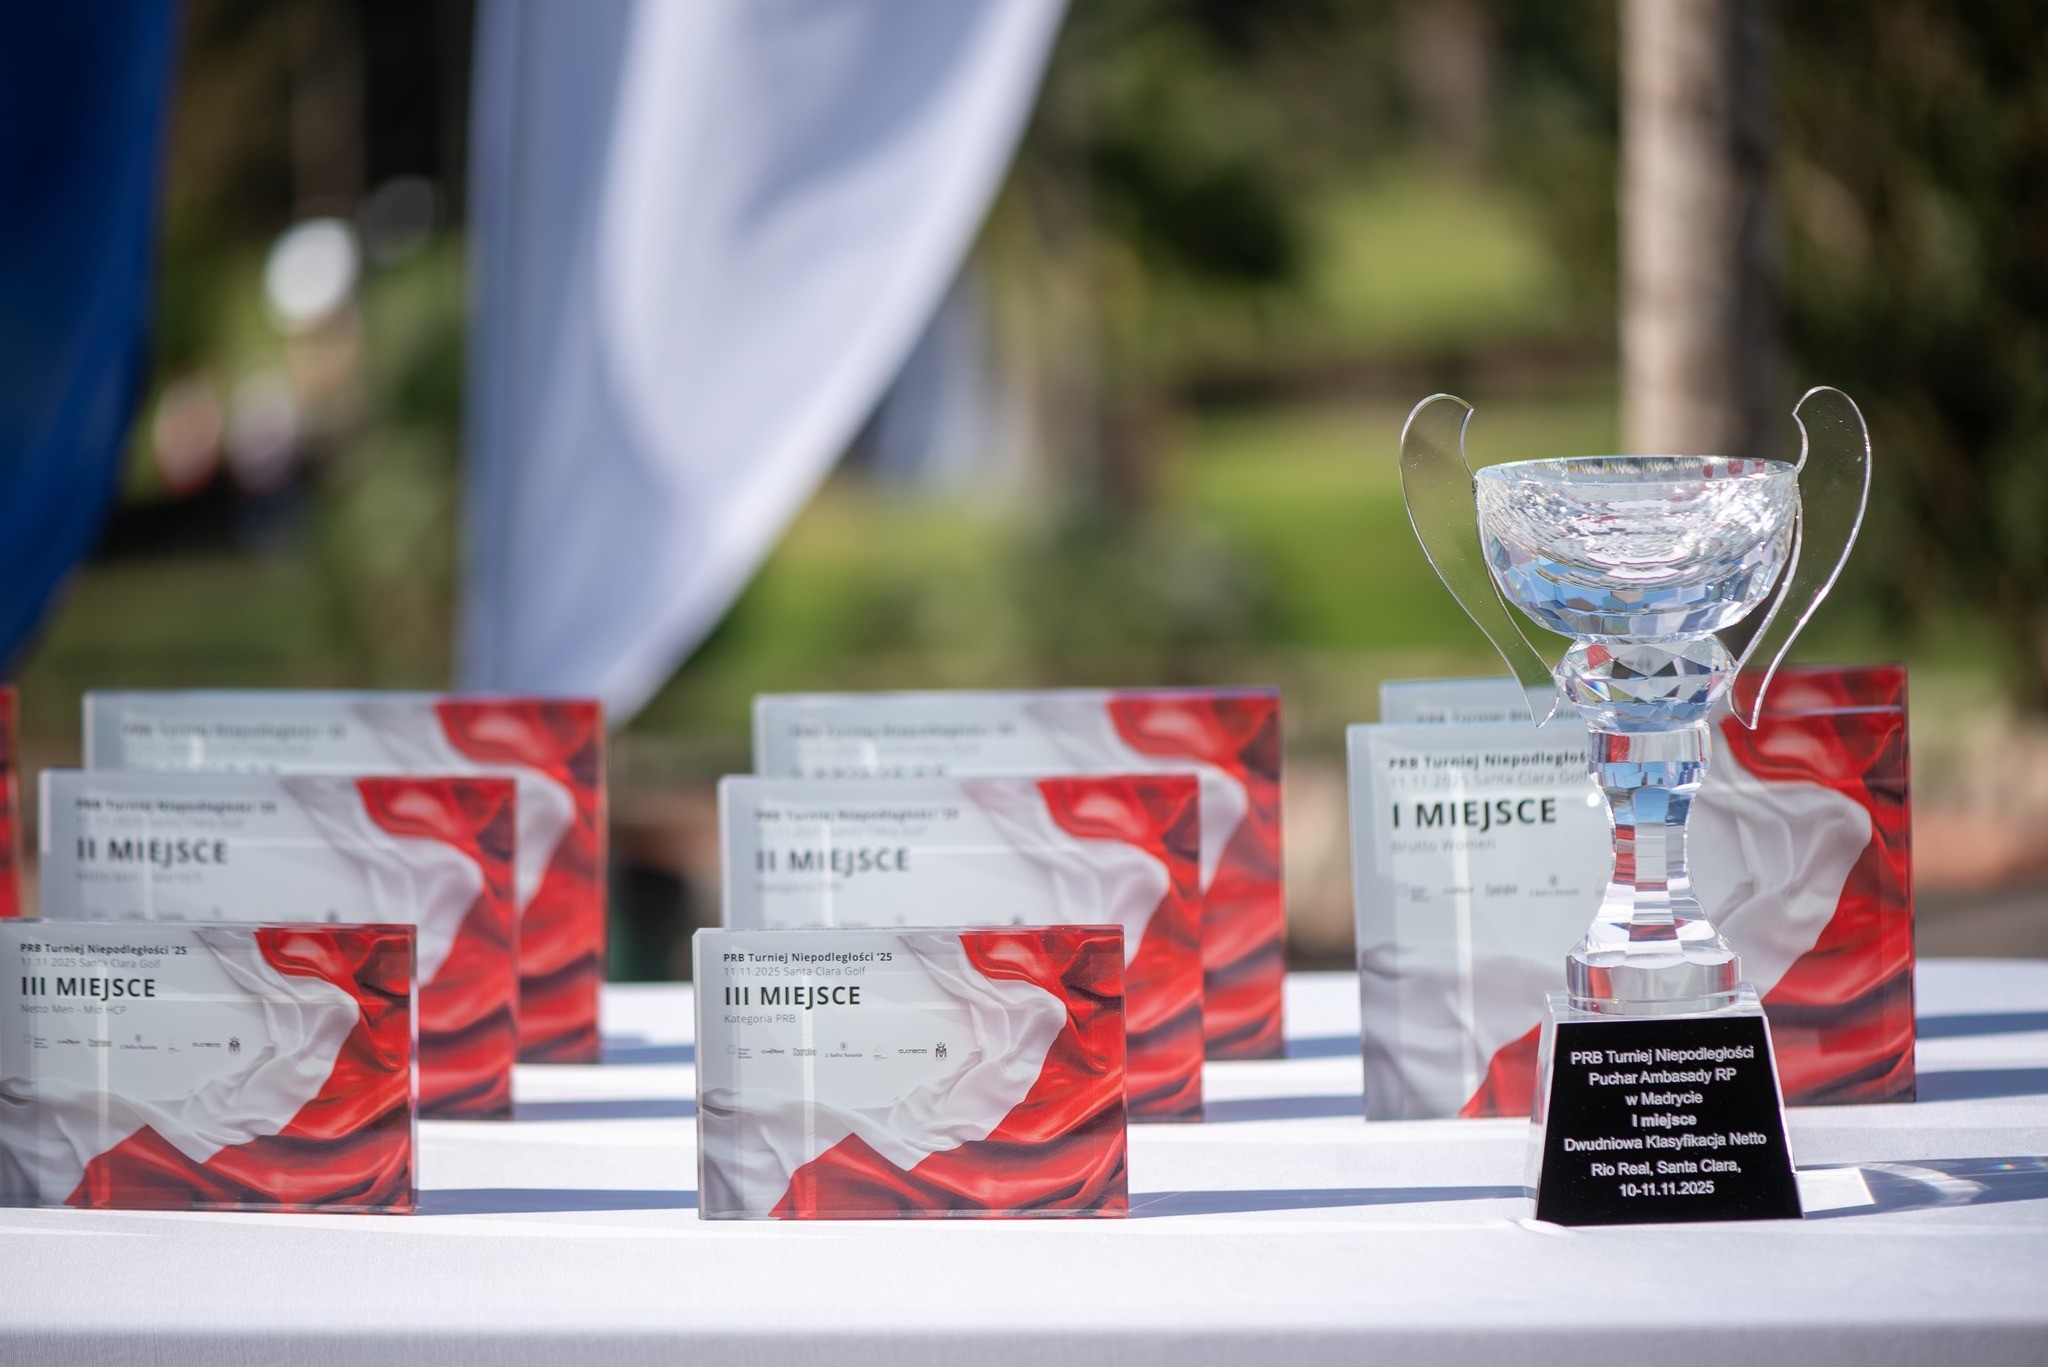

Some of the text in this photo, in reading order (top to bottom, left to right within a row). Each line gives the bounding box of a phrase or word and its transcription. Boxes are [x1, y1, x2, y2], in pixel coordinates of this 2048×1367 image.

[1389, 750, 1587, 770] PRB Turniej Niepodległoś
[1393, 798, 1557, 832] I MIEJSCE
[76, 838, 228, 868] II MIEJSCE
[756, 848, 911, 877] II MIEJSCE
[20, 943, 41, 953] PRB
[45, 943, 84, 955] Turniej
[87, 943, 169, 956] Niepodległości
[723, 953, 745, 962] PRB
[749, 952, 788, 964] Turniej
[792, 952, 874, 964] Niepodległości
[79, 958, 108, 968] Santa
[110, 958, 137, 968] Clara
[140, 958, 161, 969] Golf
[724, 966, 867, 976] 11.11.2025 Santa Clara Golf
[21, 976, 156, 1001] III MIEJSCE
[725, 986, 861, 1010] III MIEJSCE
[20, 1003, 49, 1014] Netto
[52, 1004, 75, 1014] Men
[106, 1005, 128, 1015] HCP
[724, 1013, 796, 1025] Kategoria PRB
[1570, 1045, 1755, 1065] PRB Turniej Niepodległości
[1588, 1067, 1737, 1086] Puchar Ambasady RP
[1625, 1091, 1703, 1107] w Madrycie
[1632, 1113, 1697, 1129] I miejsce
[1563, 1132, 1767, 1152] Dwudniowa Klasyfikacja Netto
[1591, 1158, 1742, 1177] Rio Real, Santa Clara,
[1619, 1180, 1715, 1198] 10-11.11.2025
